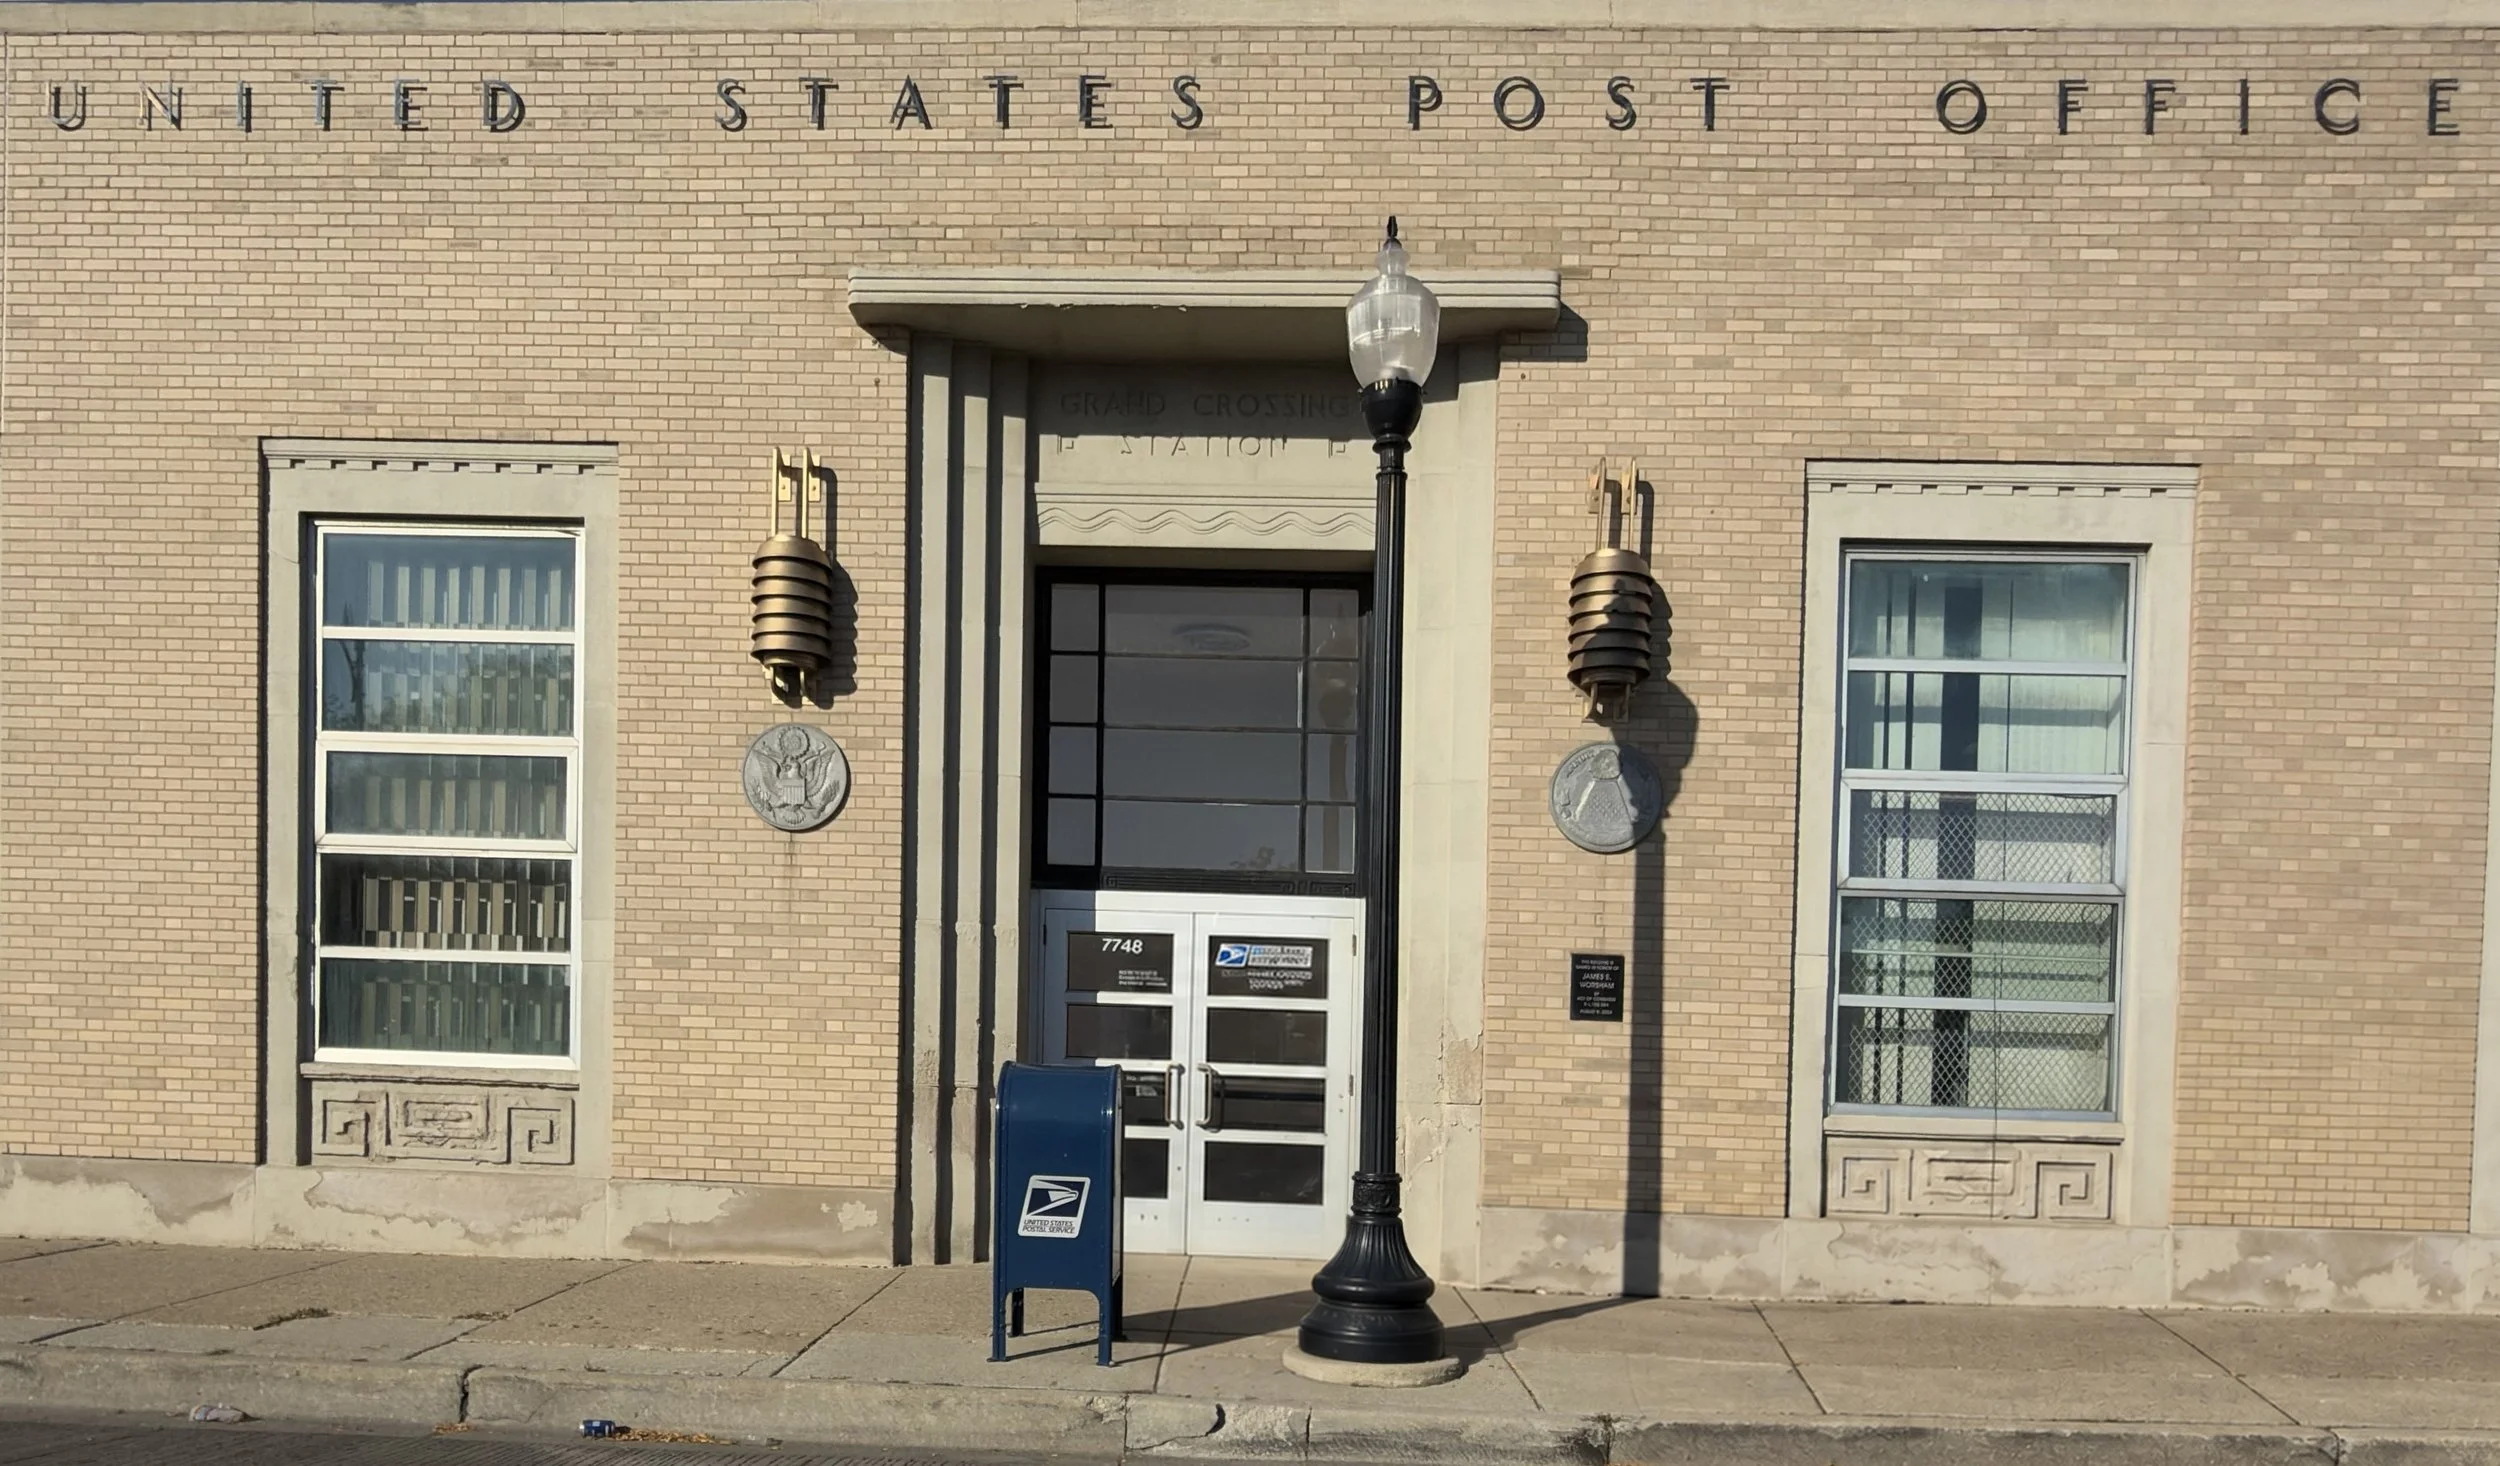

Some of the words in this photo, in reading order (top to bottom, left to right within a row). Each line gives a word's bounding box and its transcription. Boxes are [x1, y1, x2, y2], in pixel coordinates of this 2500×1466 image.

[45, 78, 525, 132] UNITED
[714, 75, 1204, 132] STATES
[1407, 75, 1730, 132] POST
[1935, 77, 2461, 136] OFFICE
[1060, 390, 1167, 418] GRAND
[1193, 391, 1355, 418] CROSSING
[1119, 432, 1288, 457] STATION
[1101, 937, 1144, 956] 7748
[1582, 972, 1604, 981] JAMES
[1048, 1226, 1076, 1234] SERVICE
